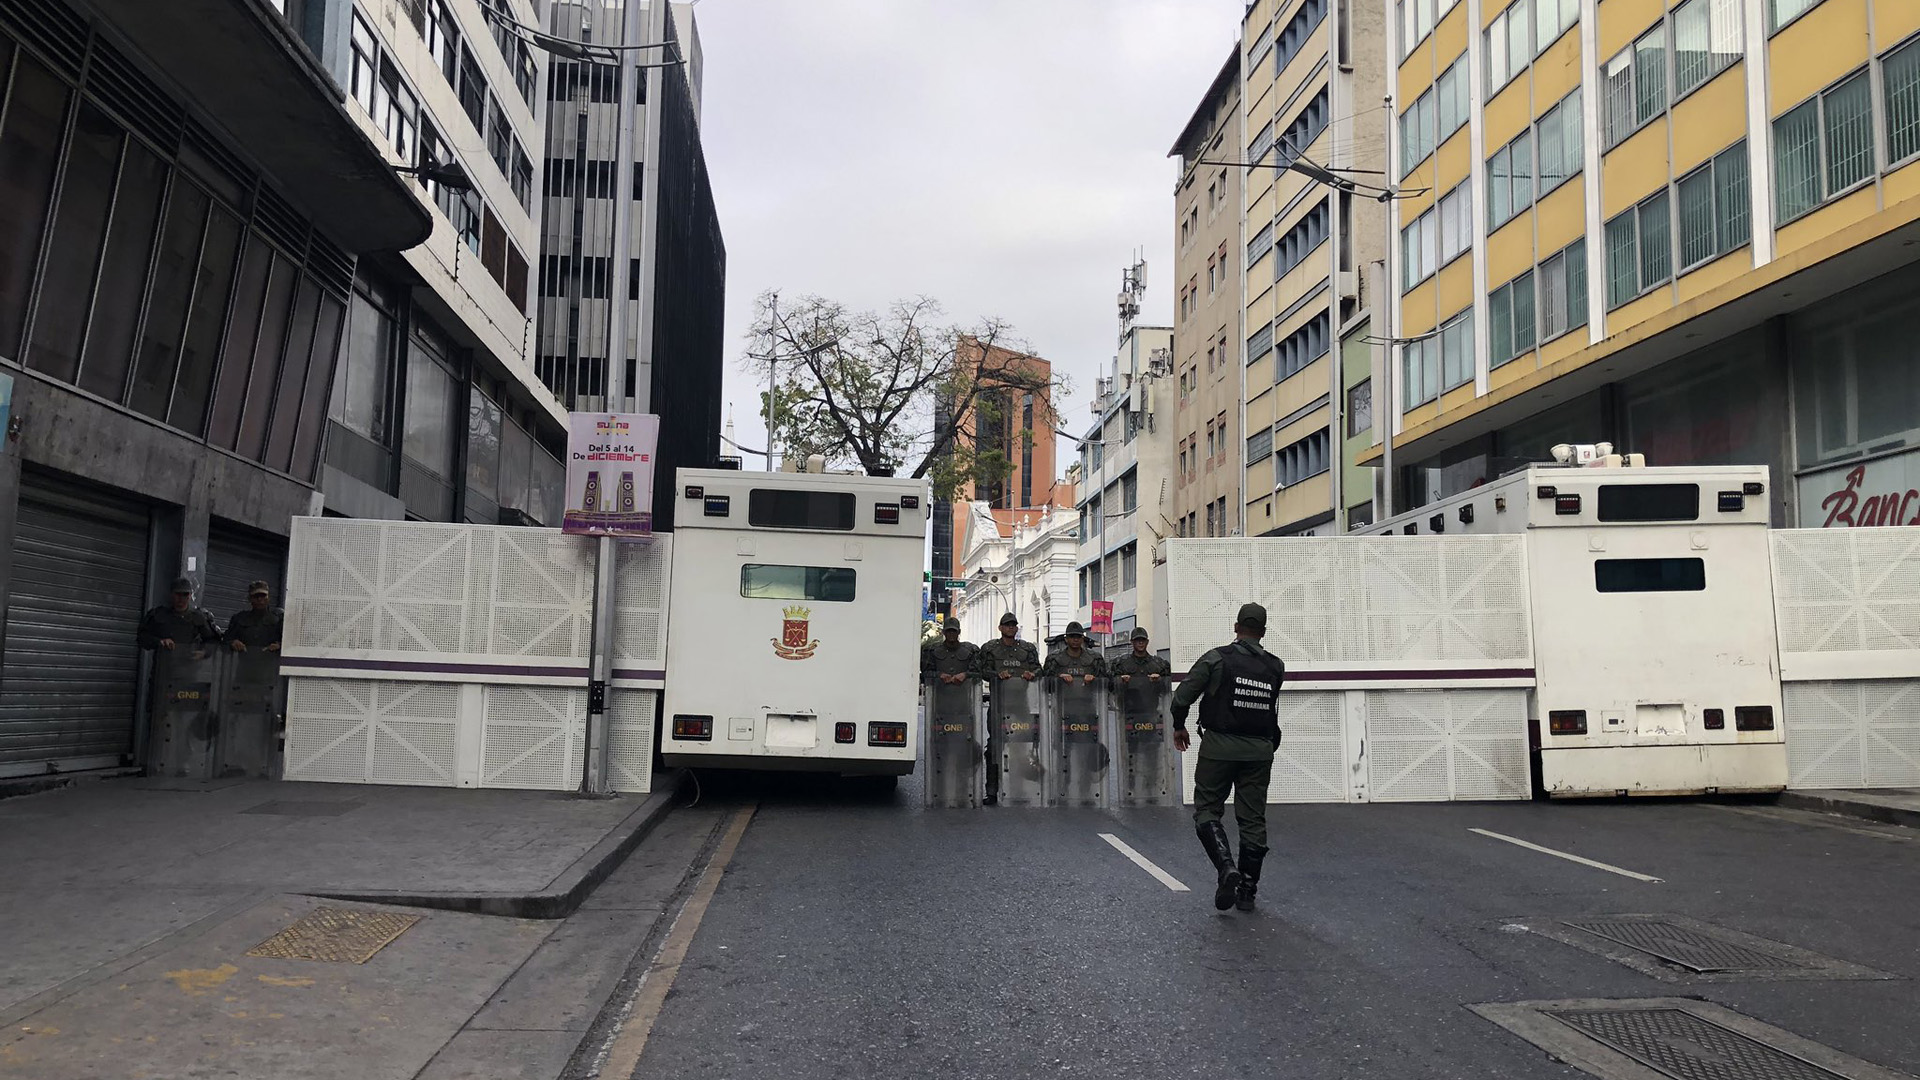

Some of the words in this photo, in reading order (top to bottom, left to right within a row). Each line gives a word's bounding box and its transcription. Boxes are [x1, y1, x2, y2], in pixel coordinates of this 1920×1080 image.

[588, 444, 603, 452] Del
[613, 445, 621, 453] al
[1822, 465, 1920, 528] Banc
[1235, 677, 1272, 690] GUARDIA
[178, 691, 199, 699] GNB
[1234, 688, 1271, 698] NACIONAL
[1233, 700, 1270, 710] BOLIVARIANA
[944, 723, 963, 732] GNB
[1010, 722, 1030, 731] GNB
[1070, 723, 1090, 732] GNB
[1134, 723, 1154, 731] GNB
